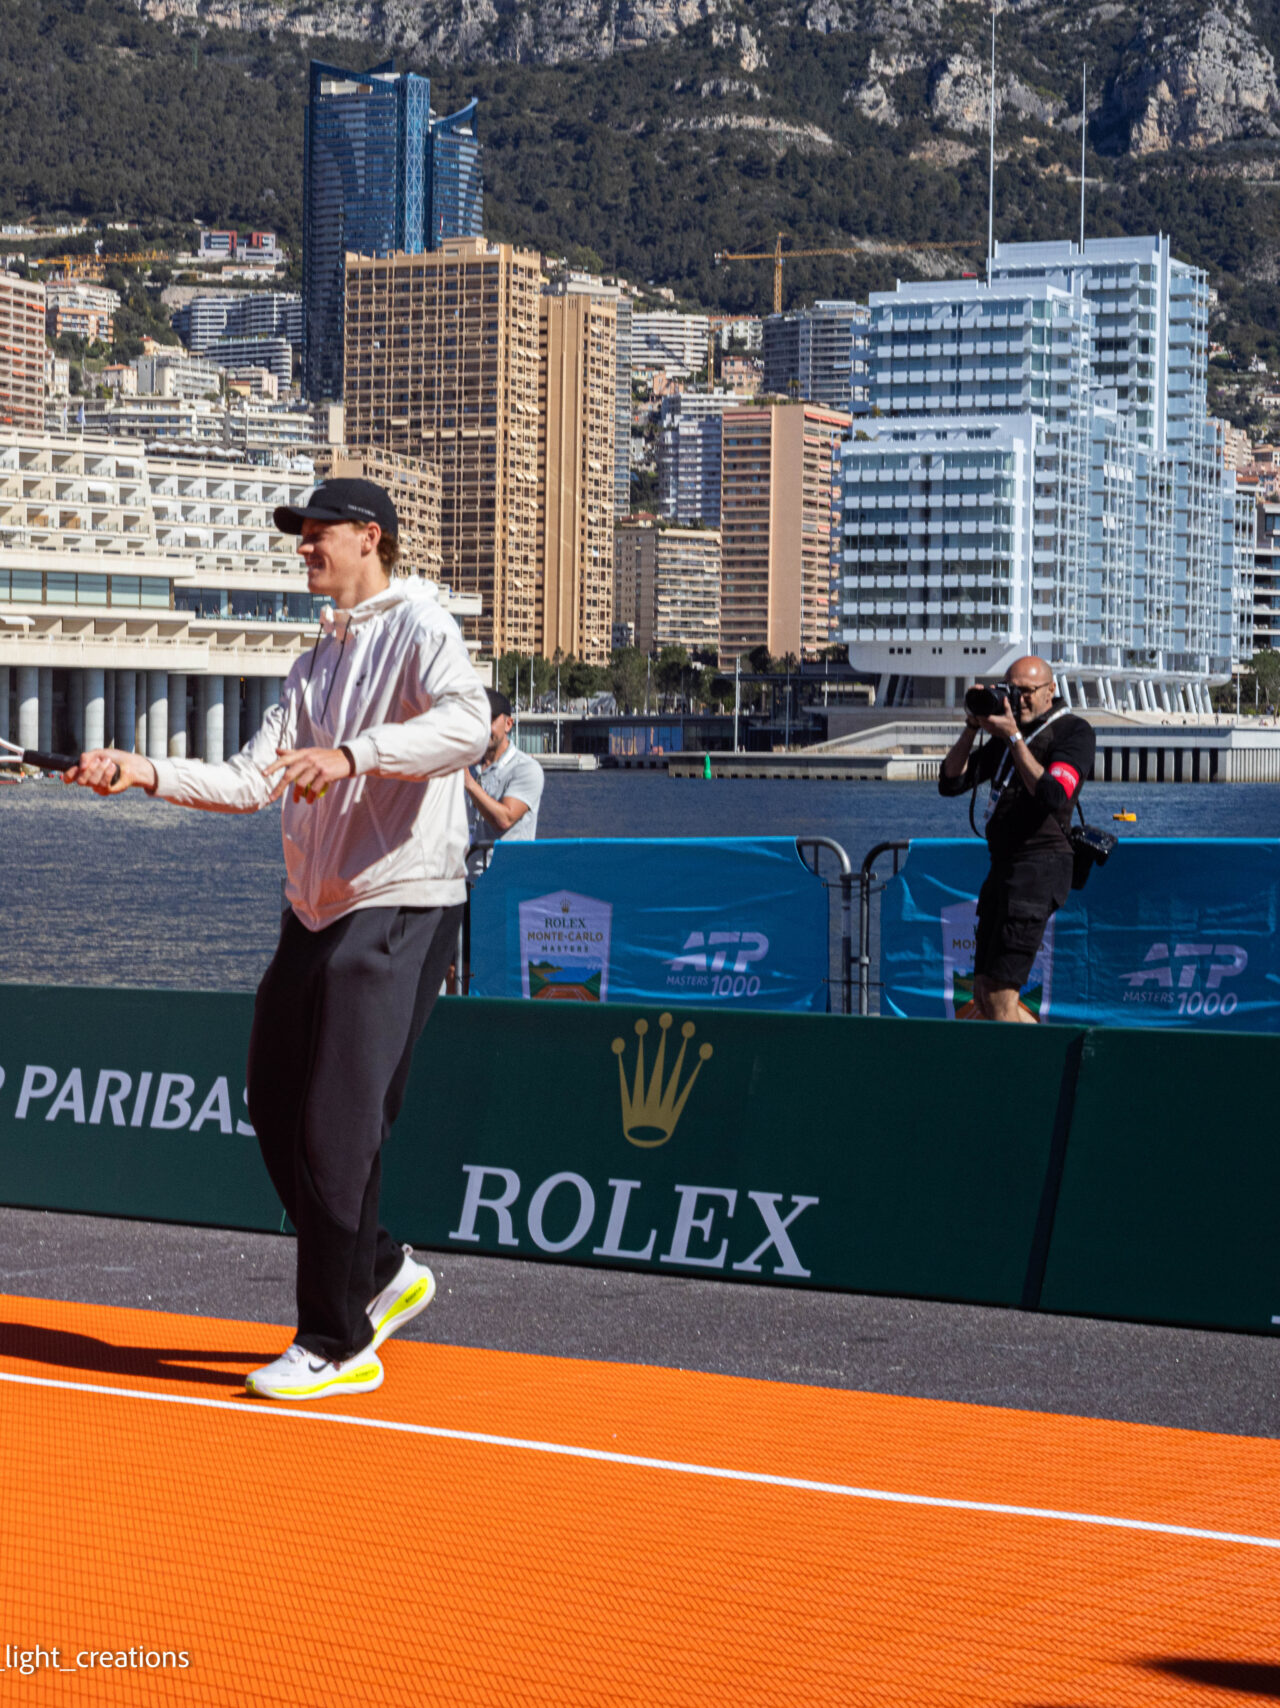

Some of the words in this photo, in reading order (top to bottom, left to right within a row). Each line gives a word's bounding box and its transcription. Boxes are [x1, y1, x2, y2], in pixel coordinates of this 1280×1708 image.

[544, 916, 586, 929] ROLEX
[662, 931, 769, 972] ATP
[1118, 943, 1248, 988] ATP
[666, 975, 709, 987] MASTERS
[711, 975, 761, 998] 1000
[1123, 991, 1175, 1003] MASTERS
[1177, 991, 1238, 1016] 1000
[448, 1164, 819, 1279] ROLEX
